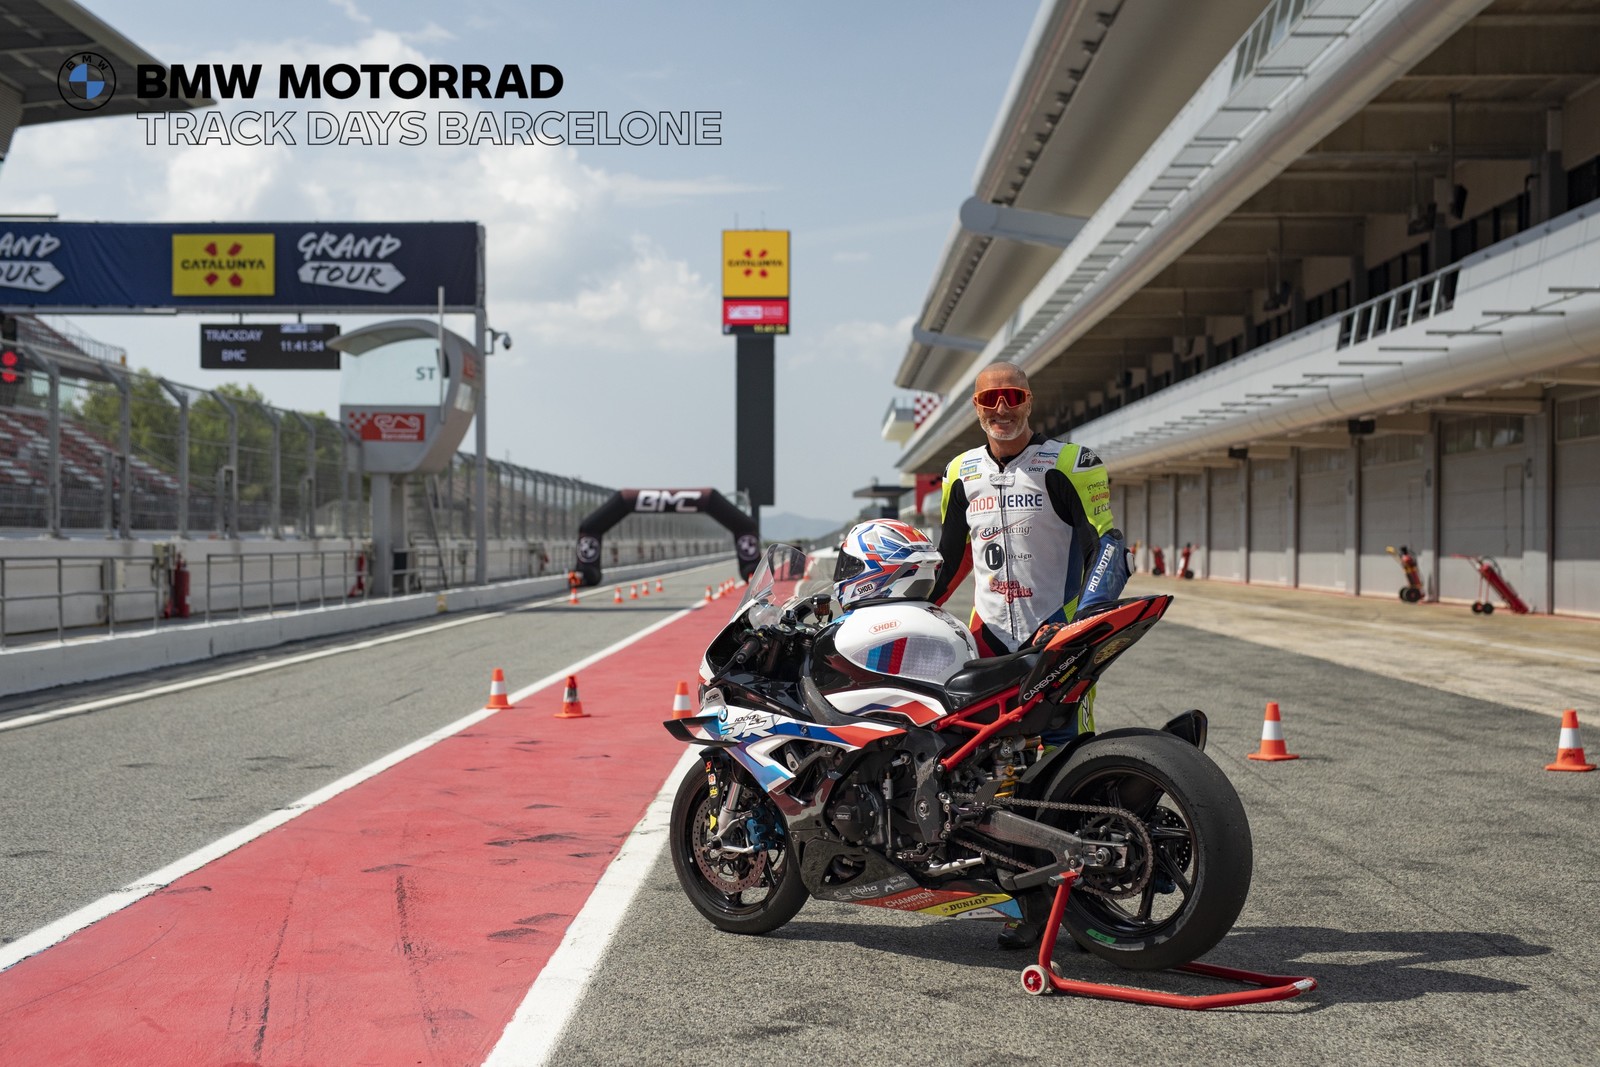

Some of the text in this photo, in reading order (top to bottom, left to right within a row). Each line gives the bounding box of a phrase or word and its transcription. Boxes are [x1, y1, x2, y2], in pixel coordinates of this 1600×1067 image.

[297, 231, 401, 261] GRAND
[181, 259, 266, 271] CATALUNYA
[310, 264, 386, 288] TOUR
[204, 329, 263, 341] TRACKDAY
[635, 490, 702, 512] BMC
[857, 583, 874, 595] SHOEI
[872, 621, 897, 633] SHOEI
[851, 884, 879, 896] alpha
[885, 891, 936, 908] CHAMPION
[949, 896, 989, 912] DUNLOP
